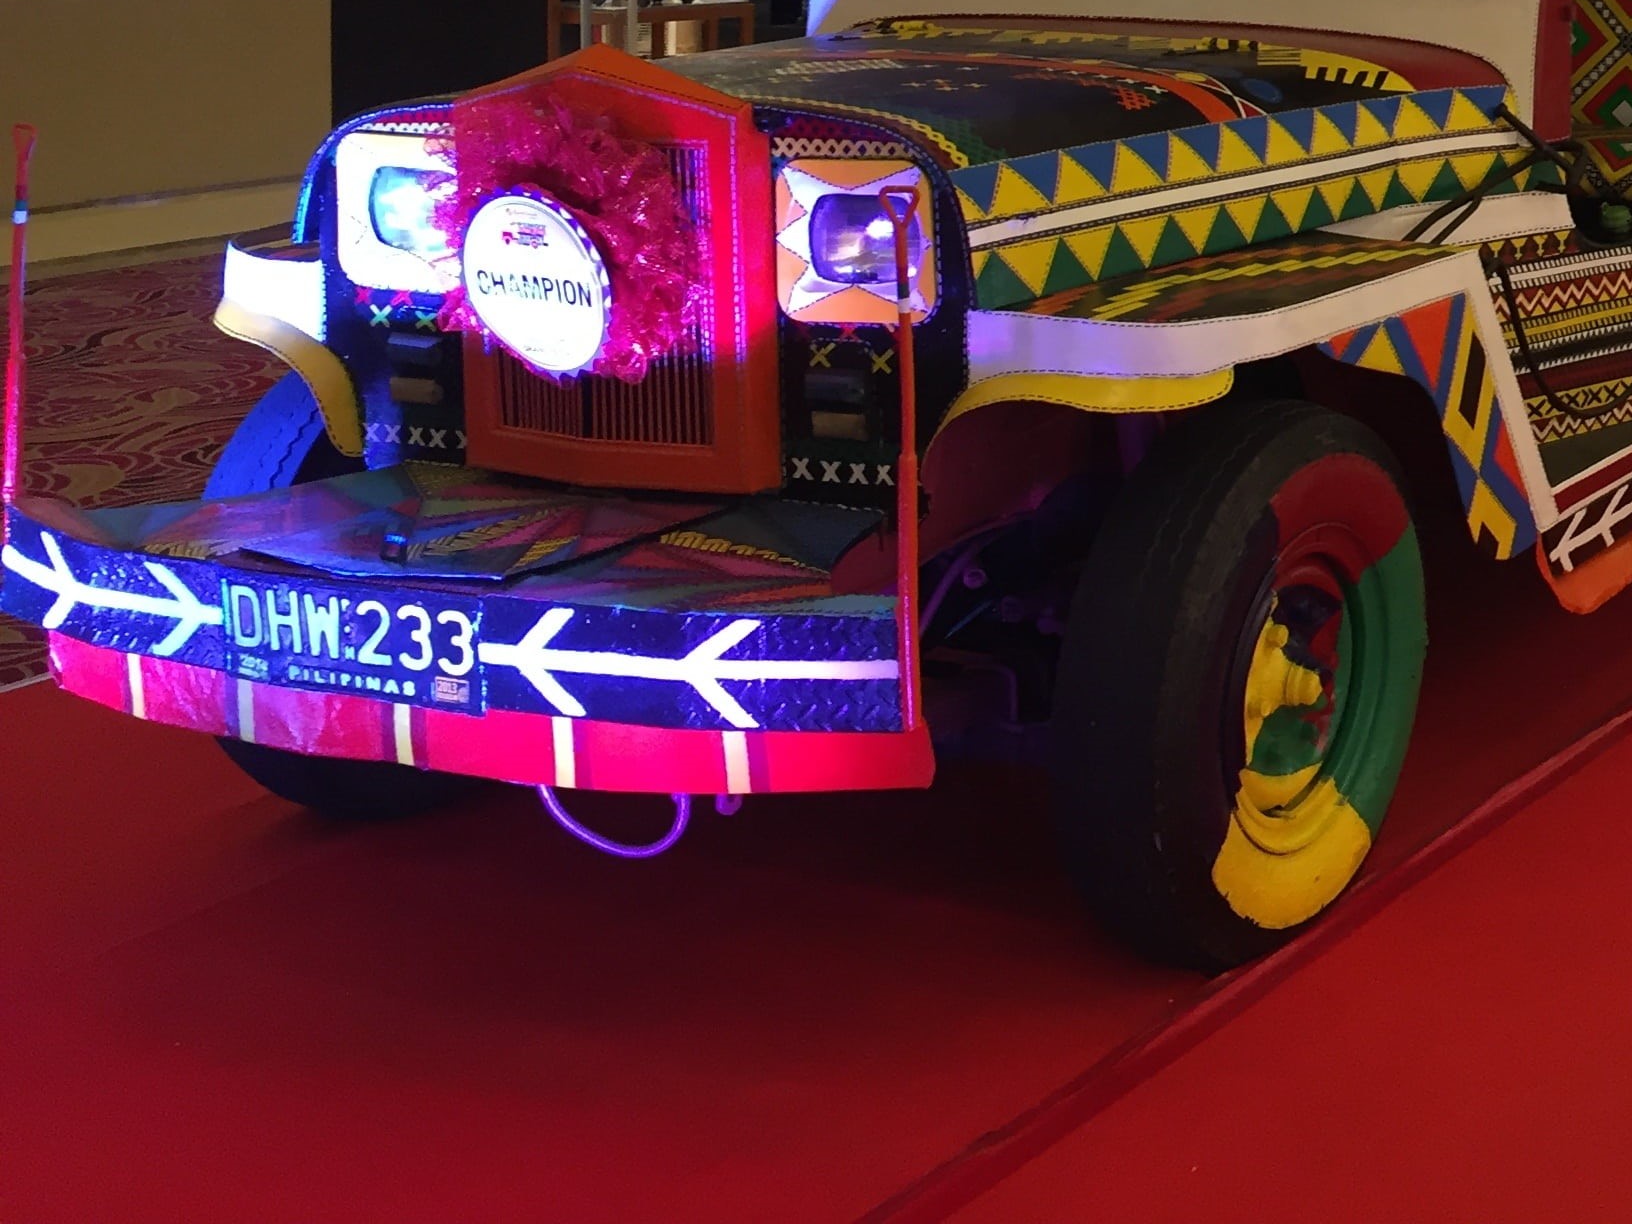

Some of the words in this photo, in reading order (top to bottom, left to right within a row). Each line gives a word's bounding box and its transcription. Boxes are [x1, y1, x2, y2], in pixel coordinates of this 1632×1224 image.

[476, 269, 592, 308] CHAMPION
[230, 584, 340, 659] DHW
[355, 600, 475, 676] 233
[288, 664, 416, 697] PILIPINAS
